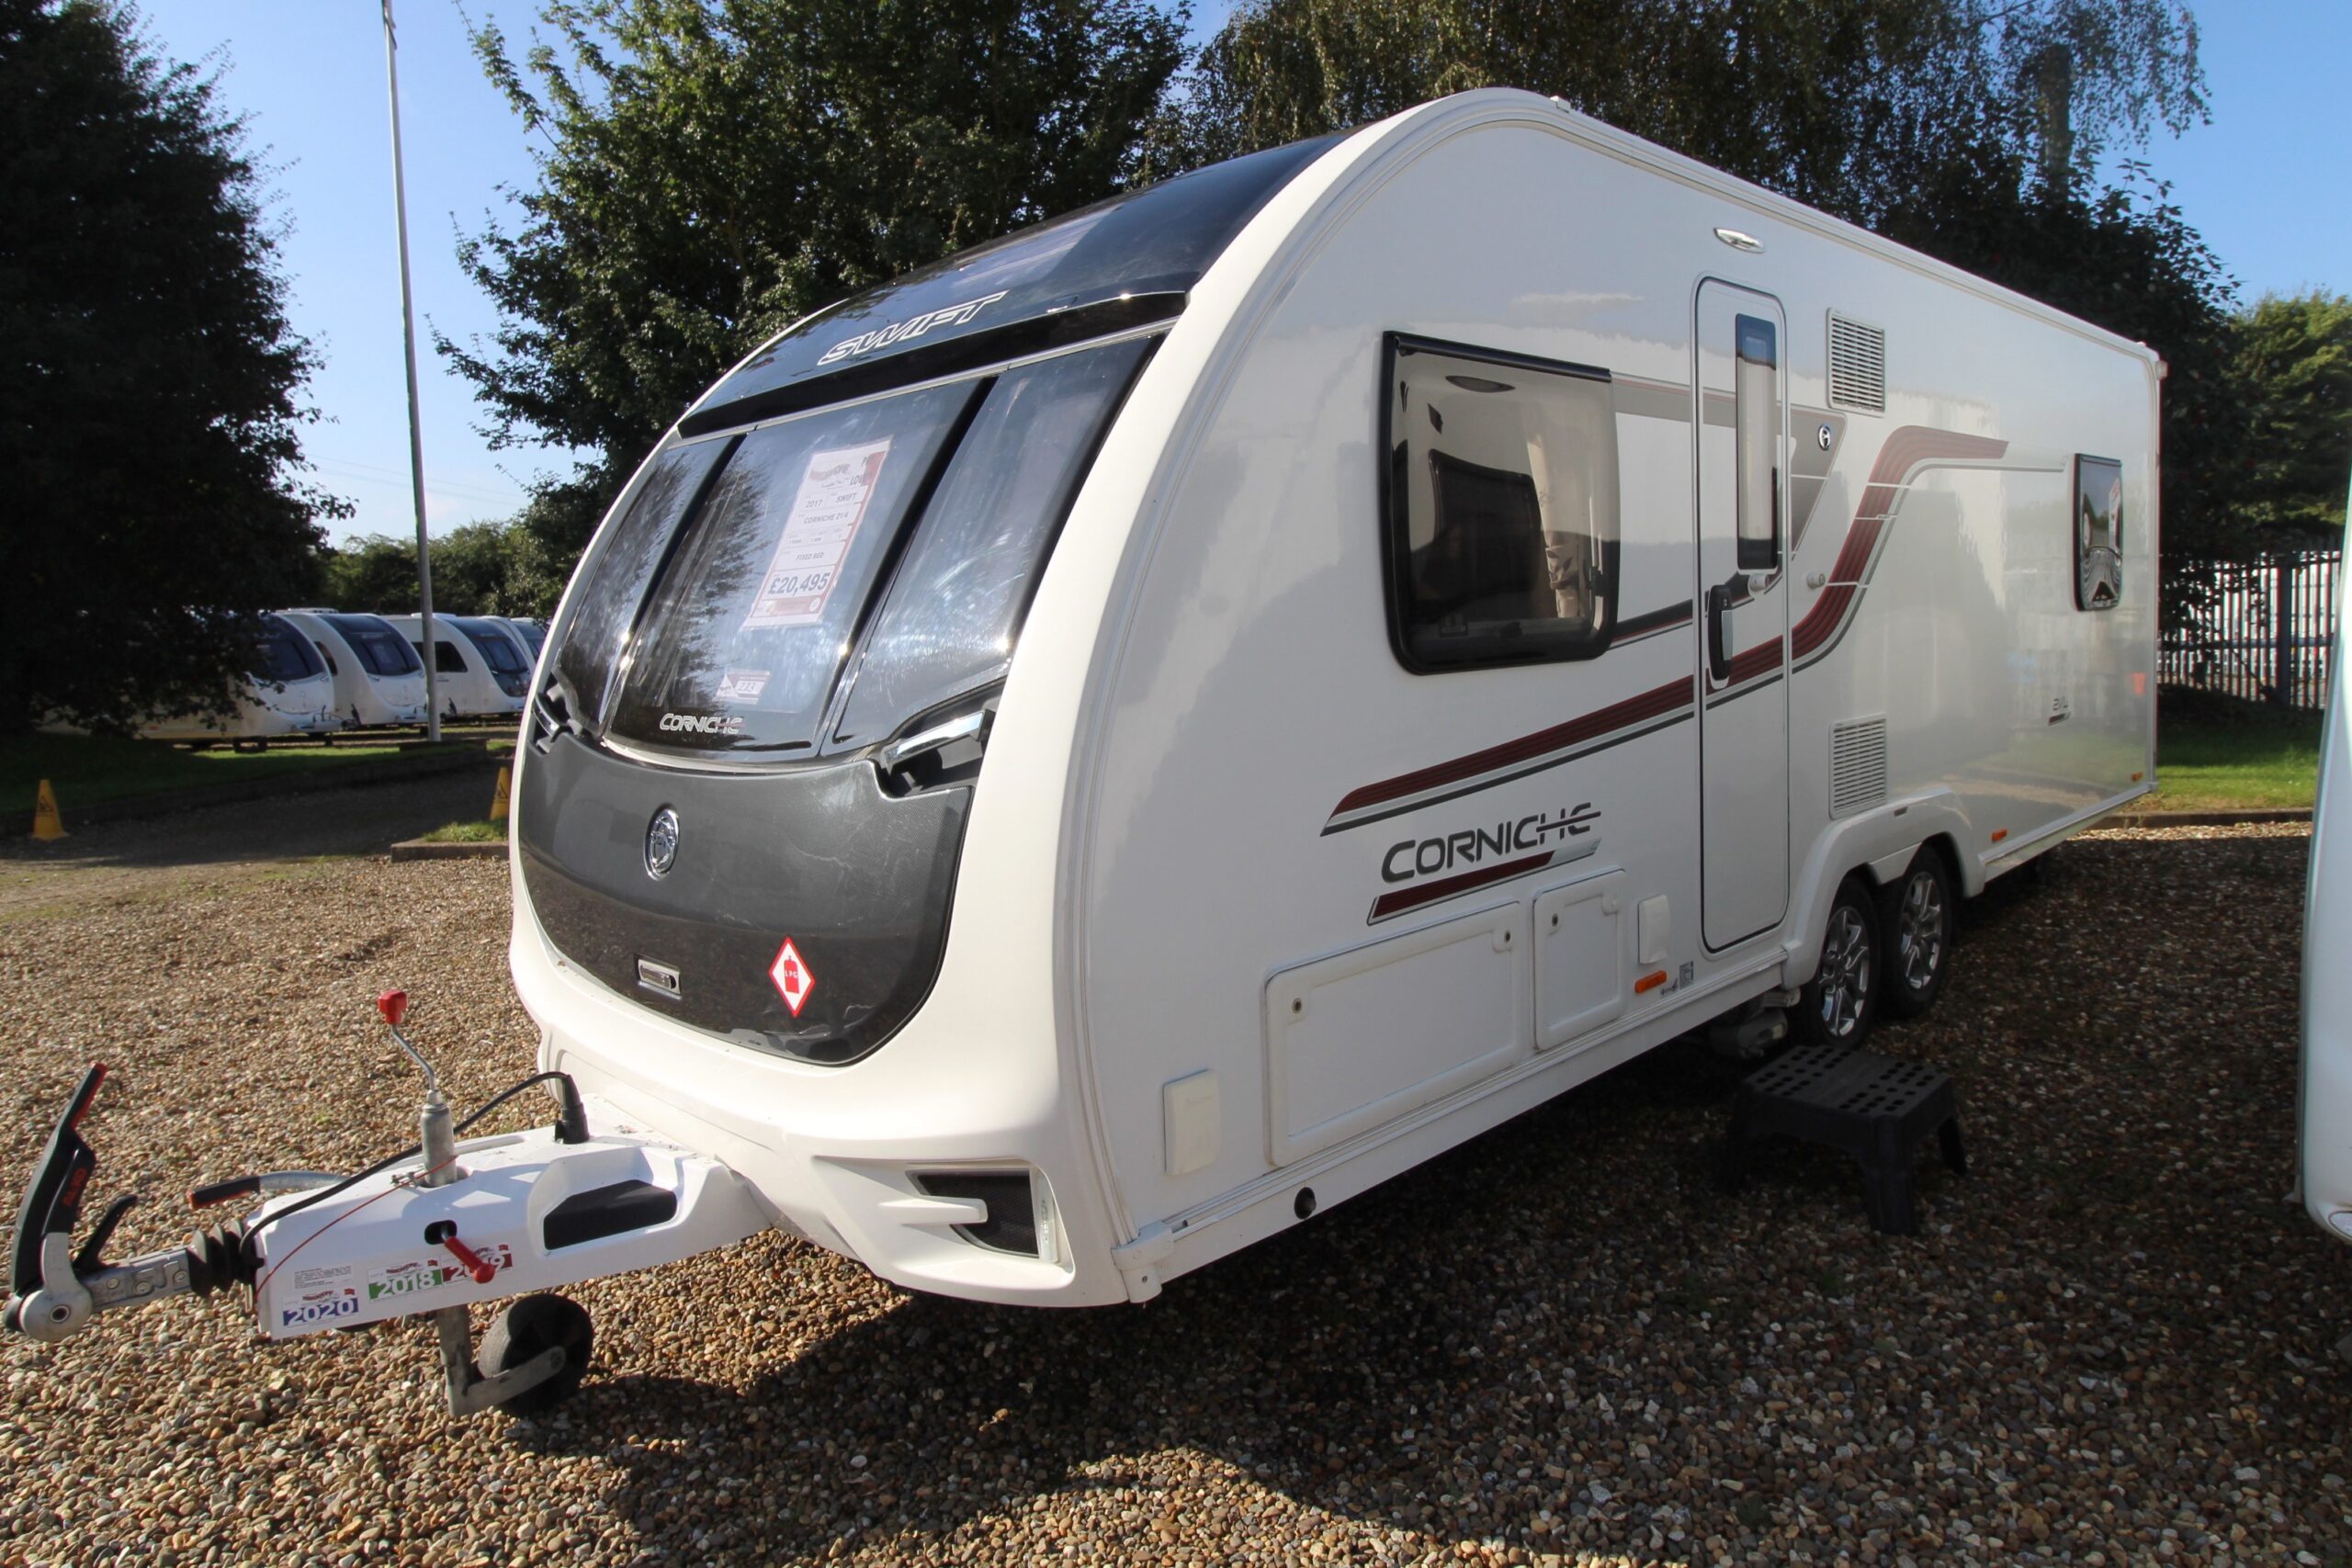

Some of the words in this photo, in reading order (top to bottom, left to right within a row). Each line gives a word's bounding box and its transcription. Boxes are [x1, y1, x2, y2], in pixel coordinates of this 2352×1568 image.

[817, 288, 1010, 367] SWIFT
[835, 492, 857, 503] SWIFT
[767, 571, 831, 596] £20,495
[660, 712, 745, 735] CORNICHE
[1380, 801, 1600, 884] CORNICHE
[785, 969, 798, 979] LPG
[449, 1253, 506, 1282] 209
[377, 1270, 436, 1299] 2018
[287, 1297, 355, 1327] 2020
